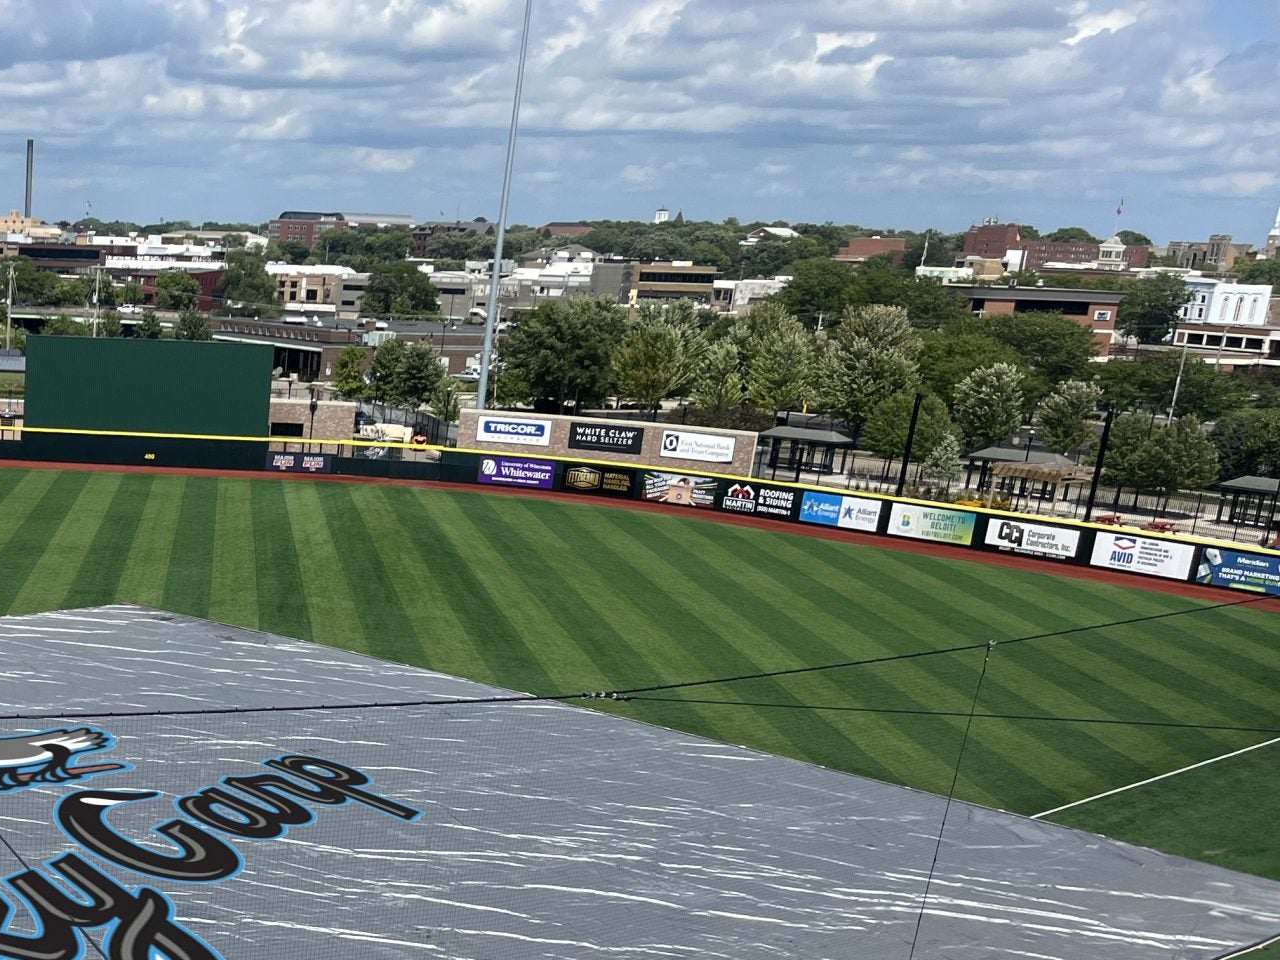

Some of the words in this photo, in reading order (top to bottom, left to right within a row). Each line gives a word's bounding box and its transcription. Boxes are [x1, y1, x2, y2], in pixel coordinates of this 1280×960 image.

[489, 422, 537, 434] TRICOR
[576, 427, 606, 436] WHITE
[609, 430, 635, 438] CLAW
[600, 437, 633, 445] SELTZER
[501, 467, 551, 479] Whitewater
[568, 470, 600, 485] FITZGERALD
[760, 489, 794, 500] ROOFING
[725, 499, 754, 510] MARTIN
[758, 496, 764, 504] &
[765, 497, 792, 508] SIDING
[818, 502, 840, 512] Alliant
[817, 510, 838, 519] Energy
[856, 507, 878, 517] Alliant
[922, 511, 955, 523] WELCOME
[957, 515, 966, 524] TO
[855, 515, 876, 524] Energy
[1027, 529, 1056, 541] Corporate
[1026, 538, 1060, 551] Contractors,
[1061, 543, 1072, 552] Inc.
[1109, 550, 1133, 564] AVID
[1237, 557, 1269, 567] Meridian
[1218, 572, 1240, 580] THAT'S
[1221, 567, 1243, 575] BRAND
[1243, 570, 1280, 580] MARKETING
